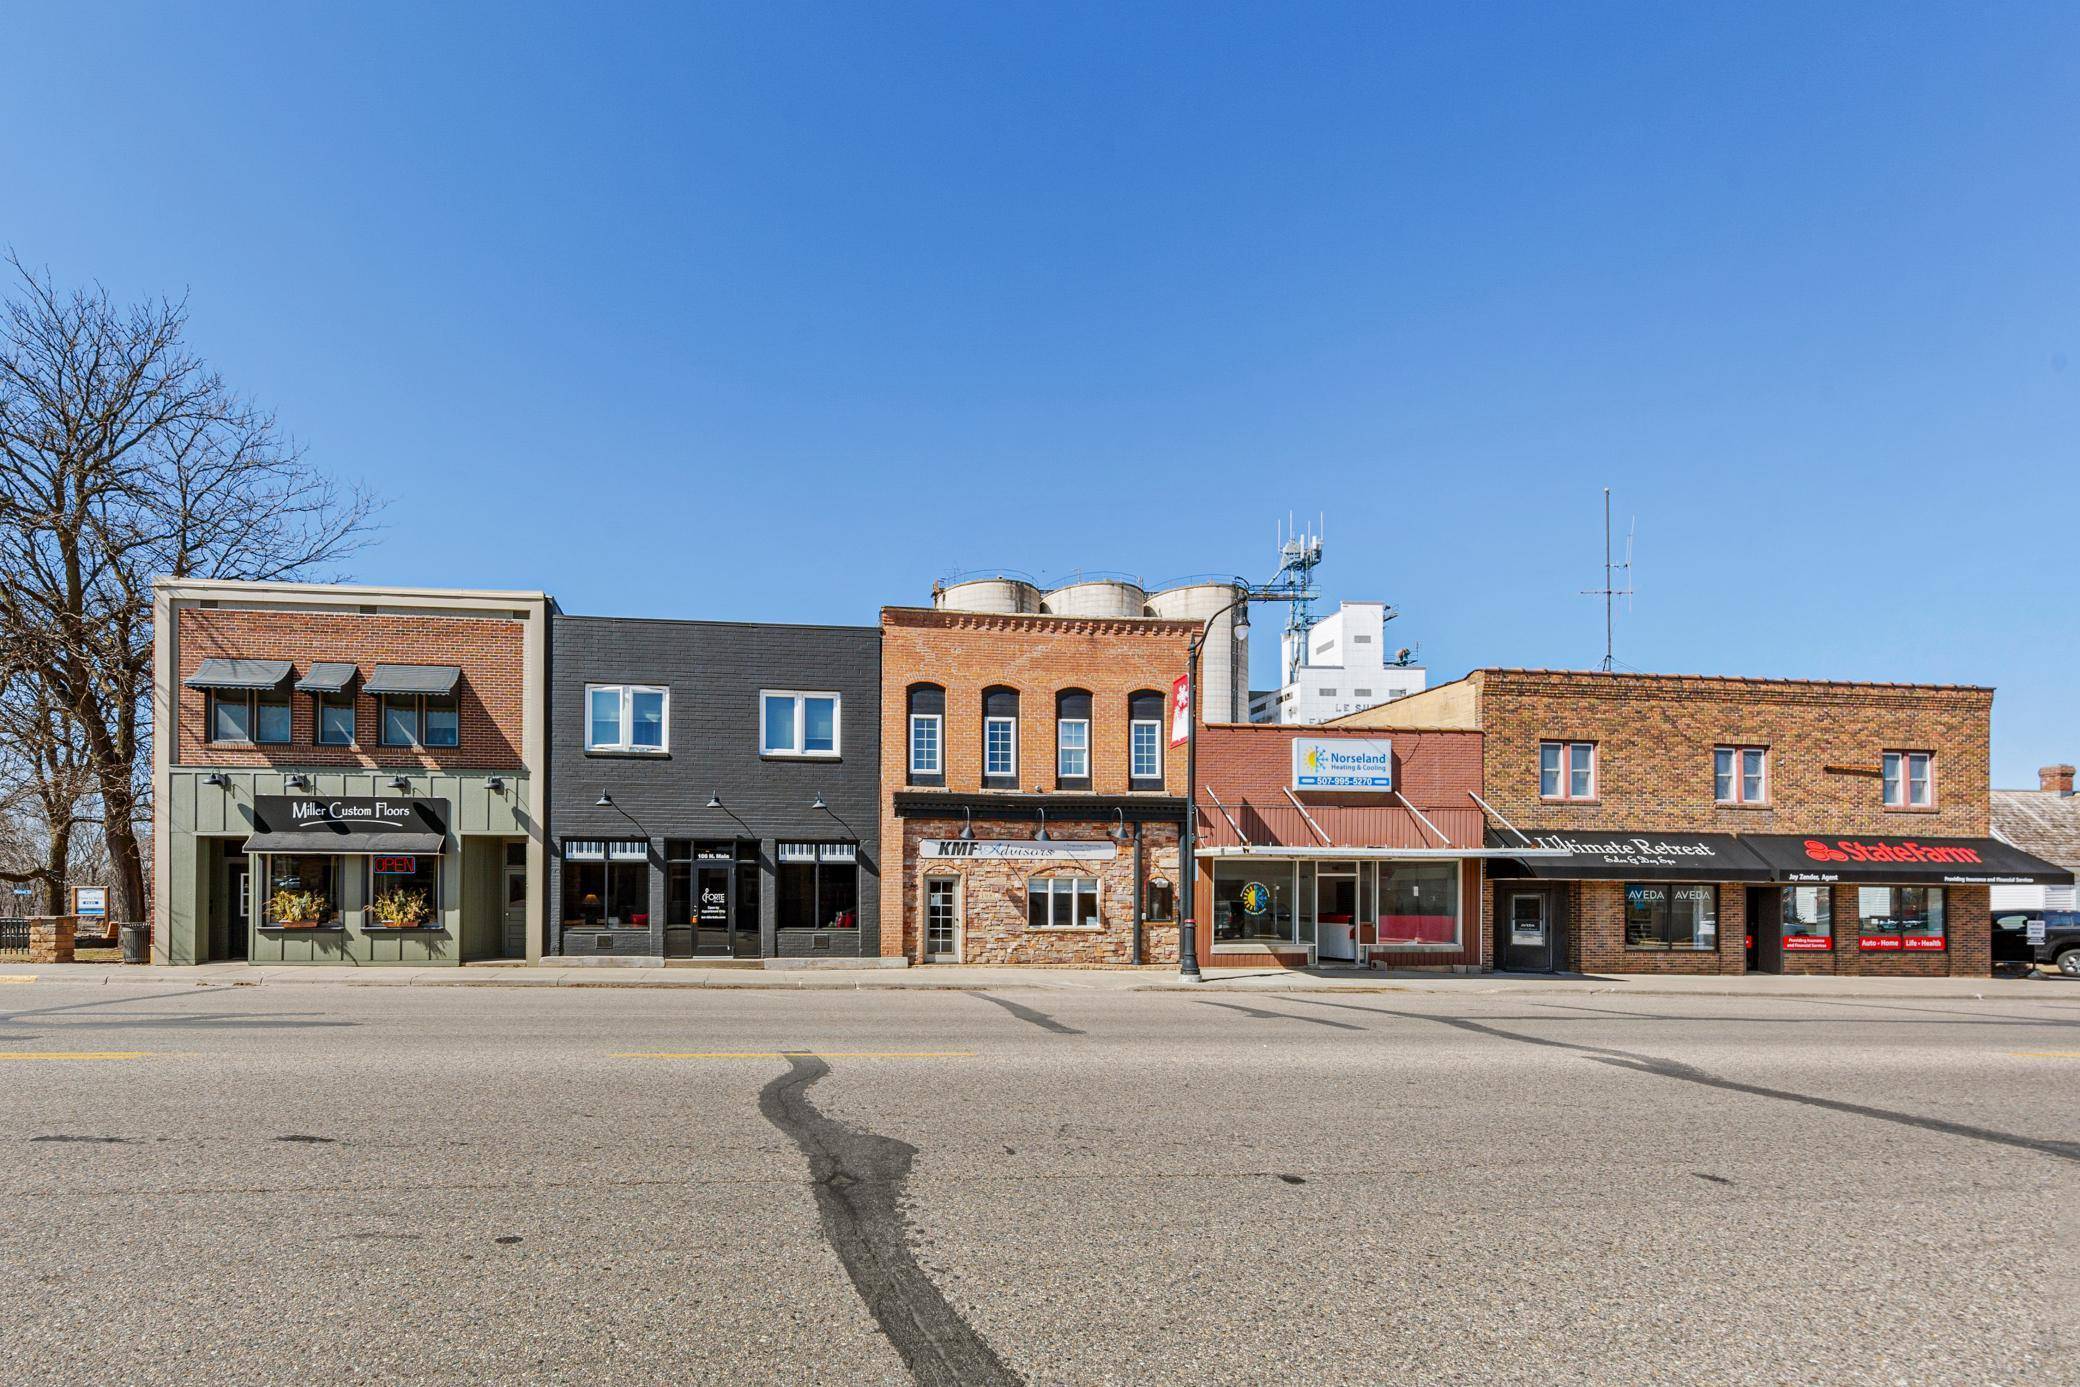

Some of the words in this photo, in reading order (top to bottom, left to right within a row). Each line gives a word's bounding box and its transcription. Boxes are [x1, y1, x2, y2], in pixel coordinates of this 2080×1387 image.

[1331, 753, 1386, 763] Norseland
[1317, 777, 1372, 785] 507-995-5270
[292, 802, 326, 818] Miller
[329, 802, 372, 818] Custom
[375, 802, 410, 818] Floors
[938, 842, 978, 855] KMF
[981, 842, 1055, 856] Advisors
[1630, 838, 1716, 856] Retreat
[375, 857, 414, 872] OPEN
[1821, 873, 1839, 882] Agent
[706, 893, 725, 901] FORTE
[1628, 890, 1665, 899] AVEDA
[1674, 891, 1711, 899] AVEDA
